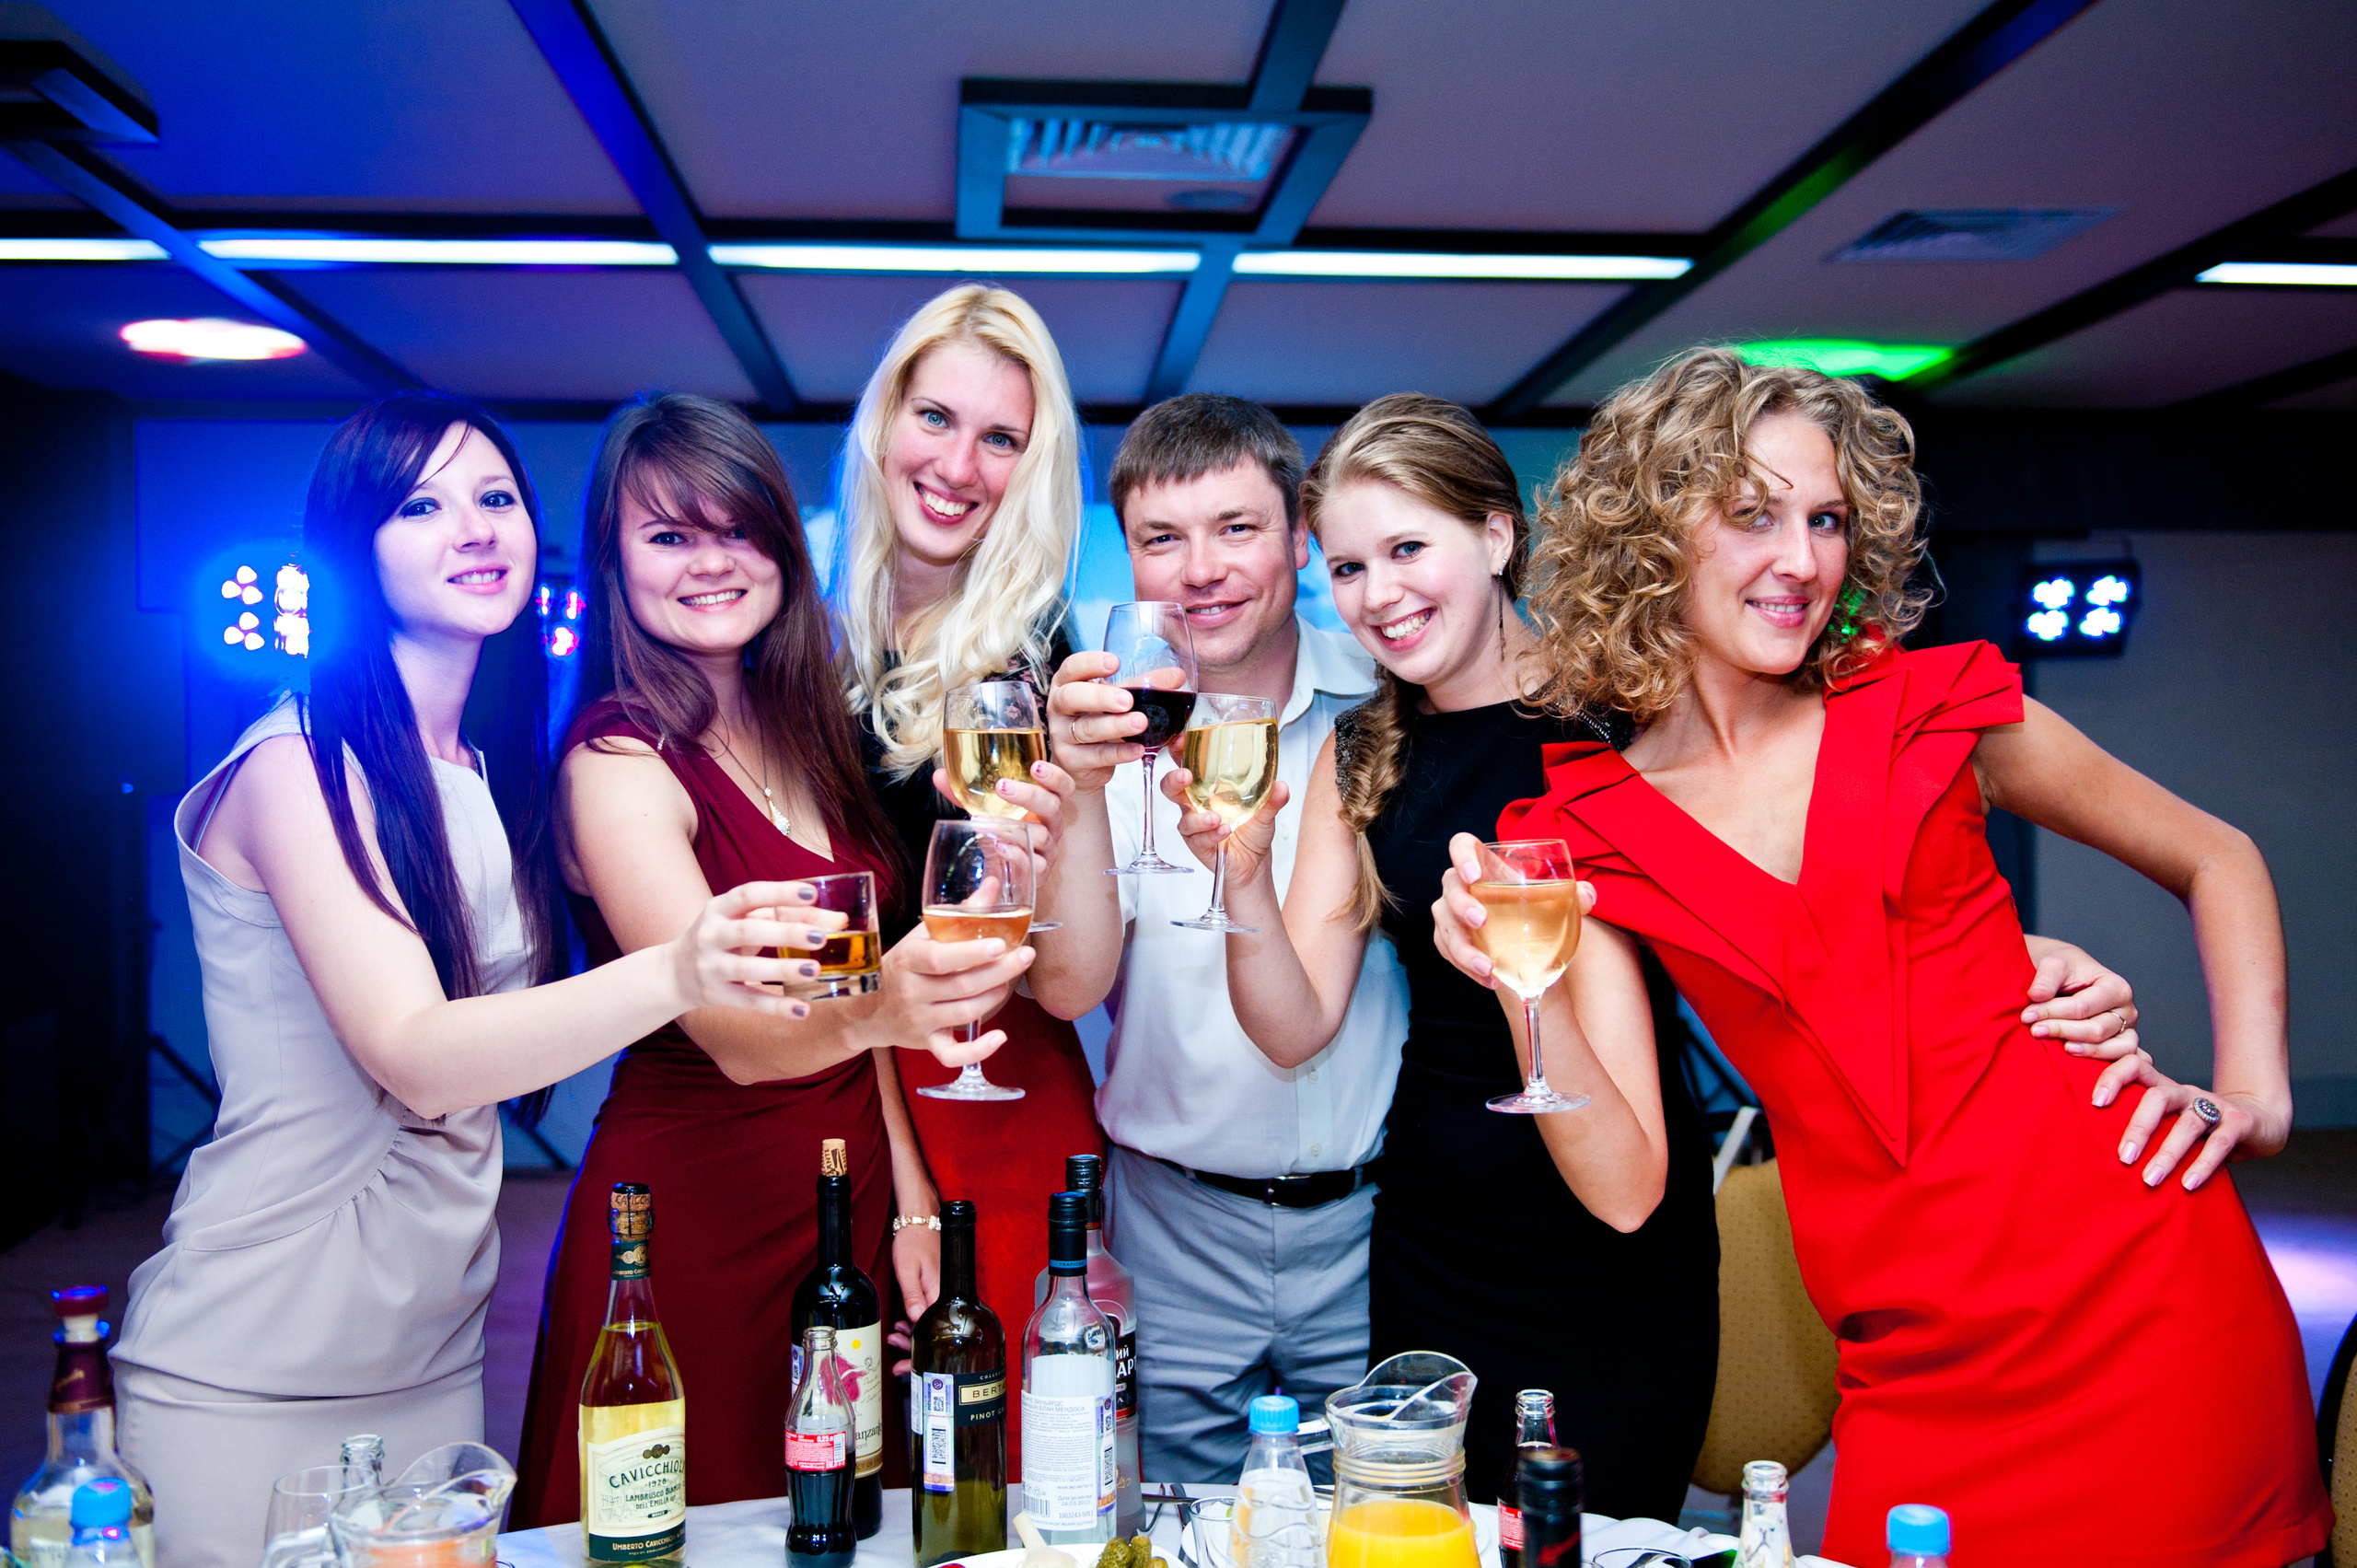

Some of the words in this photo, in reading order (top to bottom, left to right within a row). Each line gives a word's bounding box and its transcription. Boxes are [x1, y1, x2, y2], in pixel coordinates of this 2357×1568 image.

[970, 1411, 995, 1421] PINOT
[626, 1490, 664, 1502] LAMBRUSCO
[612, 1541, 644, 1551] UMBERTO
